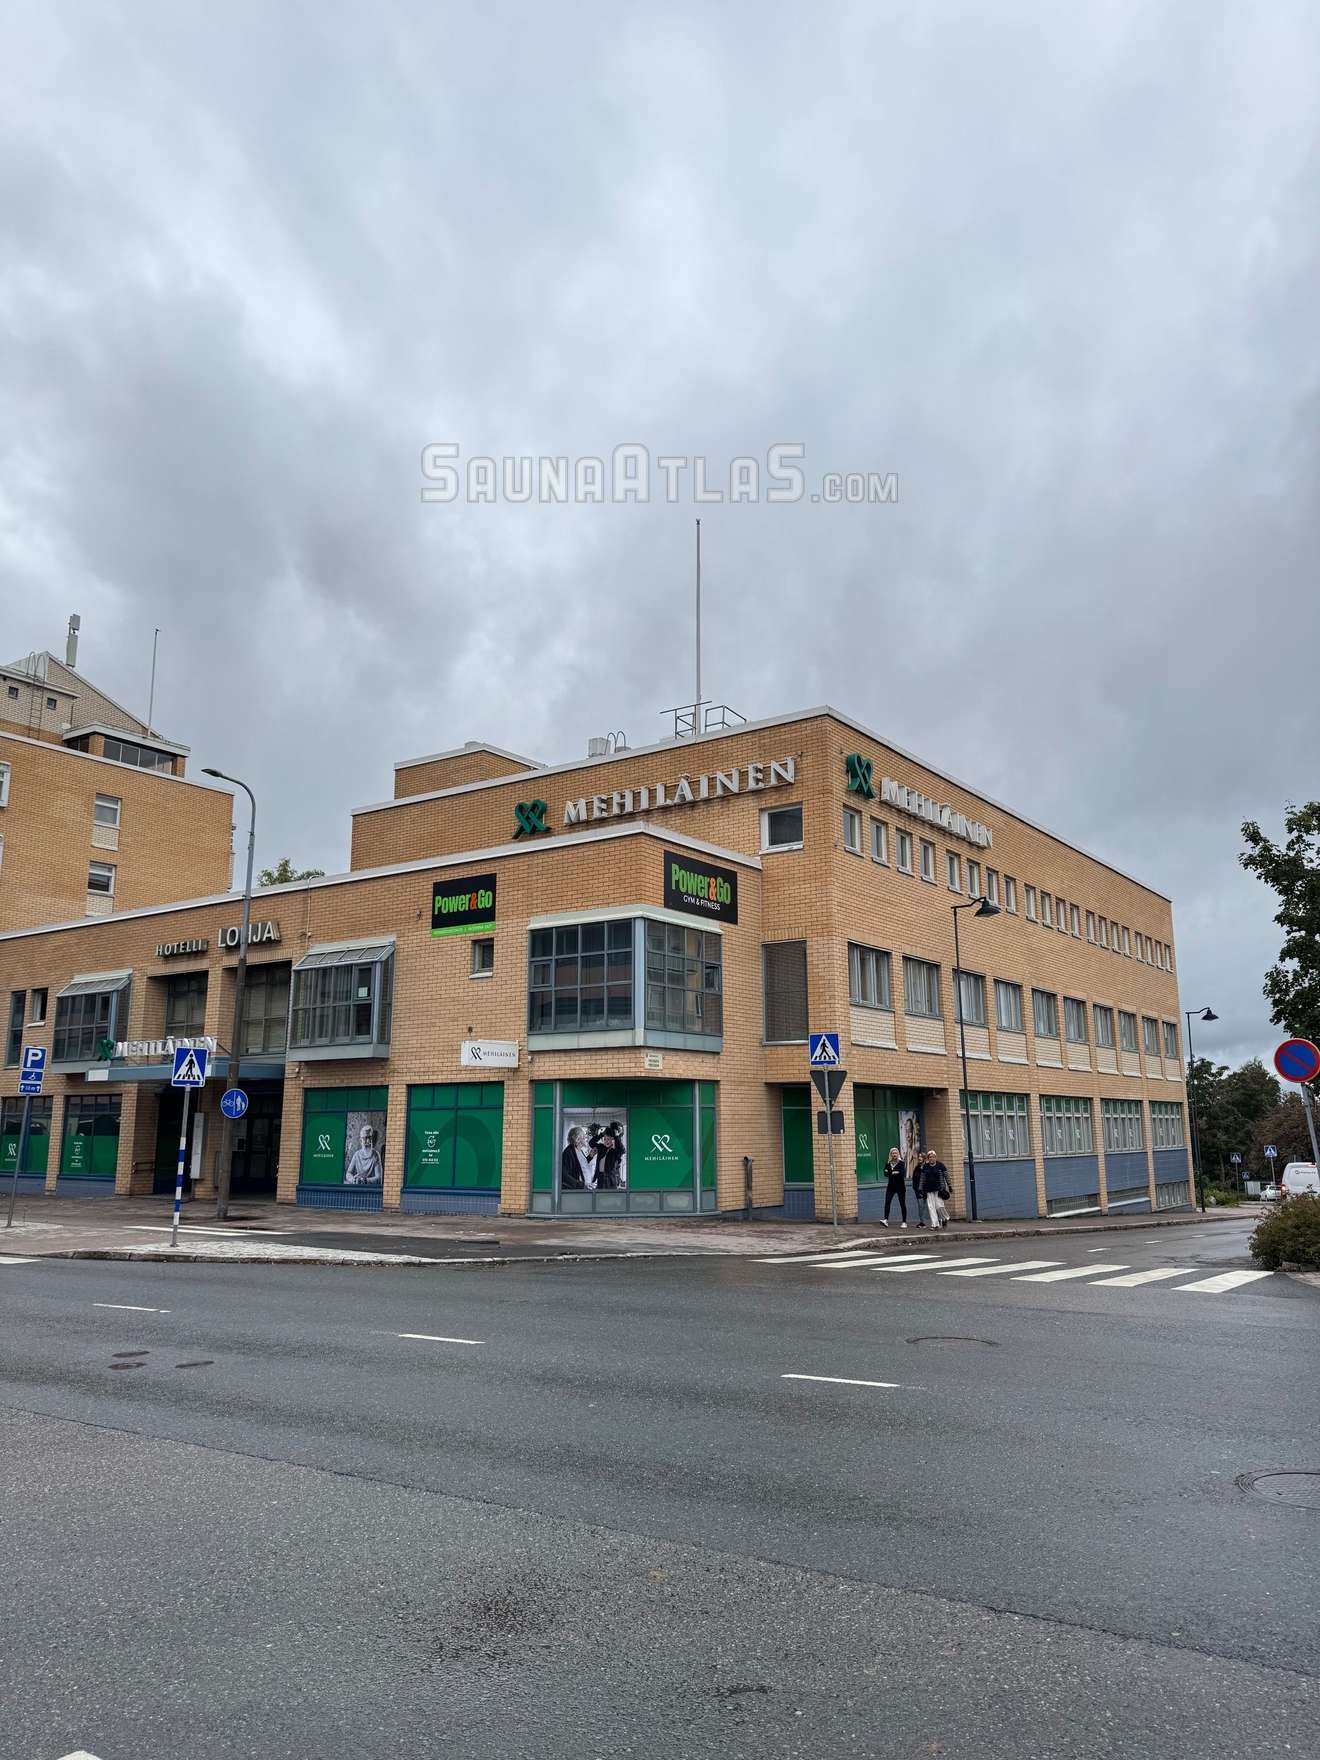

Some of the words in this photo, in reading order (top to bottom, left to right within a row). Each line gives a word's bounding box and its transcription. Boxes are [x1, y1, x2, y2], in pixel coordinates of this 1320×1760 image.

[564, 757, 796, 826] MEHILÄINEN
[683, 894, 696, 905] GYM
[700, 899, 721, 911] FITNESS
[155, 939, 206, 957] HOTELLI
[26, 1049, 42, 1068] P
